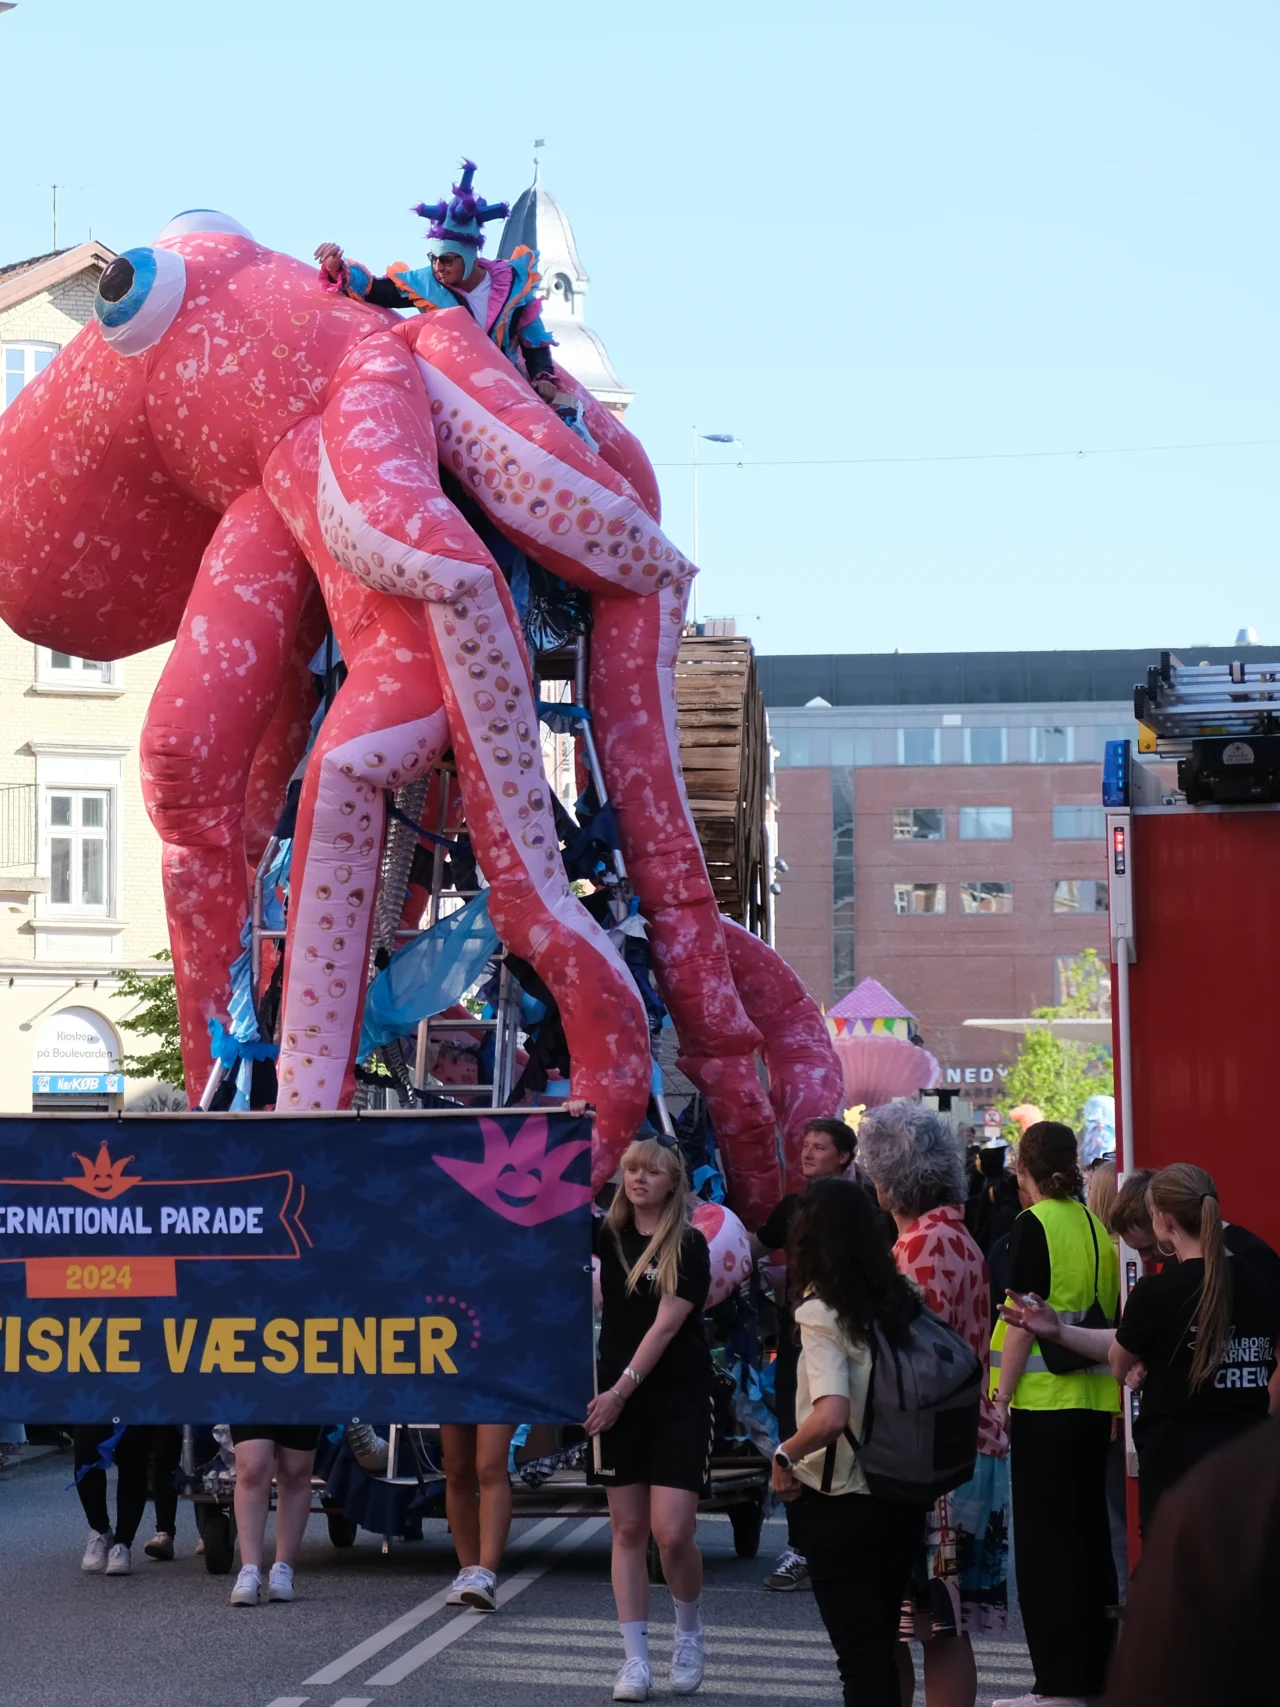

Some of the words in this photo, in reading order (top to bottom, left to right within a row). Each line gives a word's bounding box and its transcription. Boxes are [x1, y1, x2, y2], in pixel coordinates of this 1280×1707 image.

[57, 1031, 93, 1041] Kiosken
[37, 1047, 50, 1059] på
[52, 1047, 113, 1059] Boulevarden
[946, 1067, 1009, 1084] NEDY
[161, 1206, 264, 1235] PARADE
[66, 1264, 132, 1291] 2024
[163, 1315, 458, 1375] VÆSENER
[1228, 1337, 1270, 1350] ALBORG
[1221, 1347, 1273, 1364] ARNEVAL
[1214, 1366, 1268, 1389] CREW
